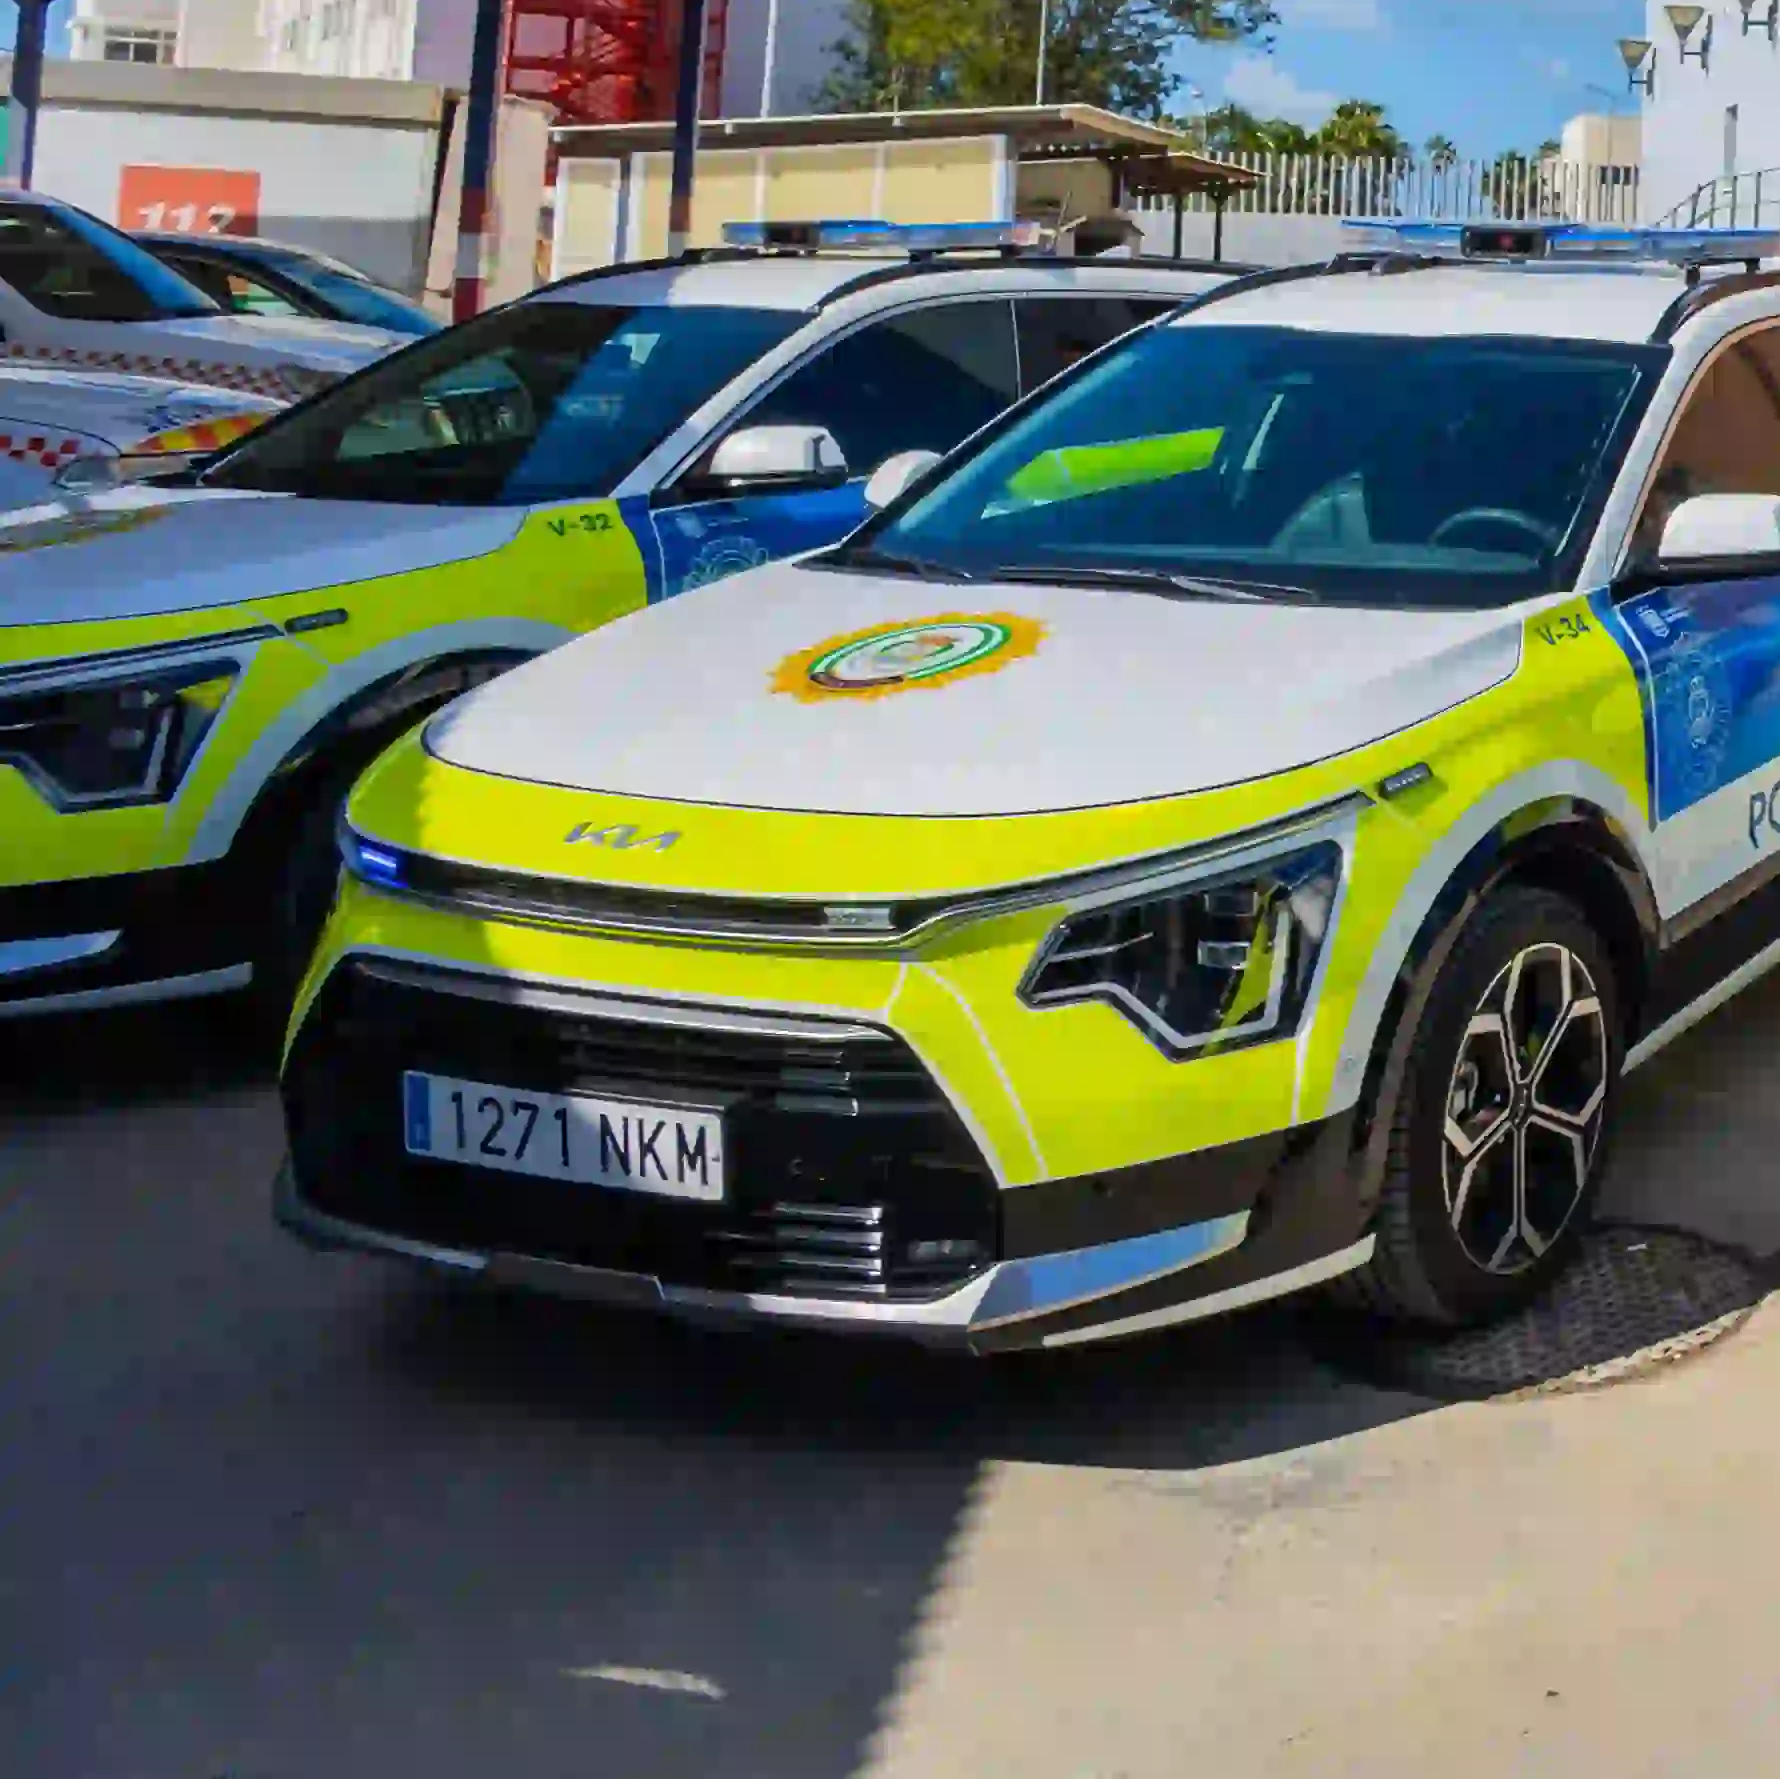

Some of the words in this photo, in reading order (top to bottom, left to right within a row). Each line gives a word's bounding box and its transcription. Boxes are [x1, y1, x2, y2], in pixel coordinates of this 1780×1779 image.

[547, 512, 613, 537] V-32
[1535, 612, 1592, 646] V-34
[563, 820, 684, 853] KIA
[450, 1090, 570, 1168] 1271
[599, 1112, 709, 1186] NKM
